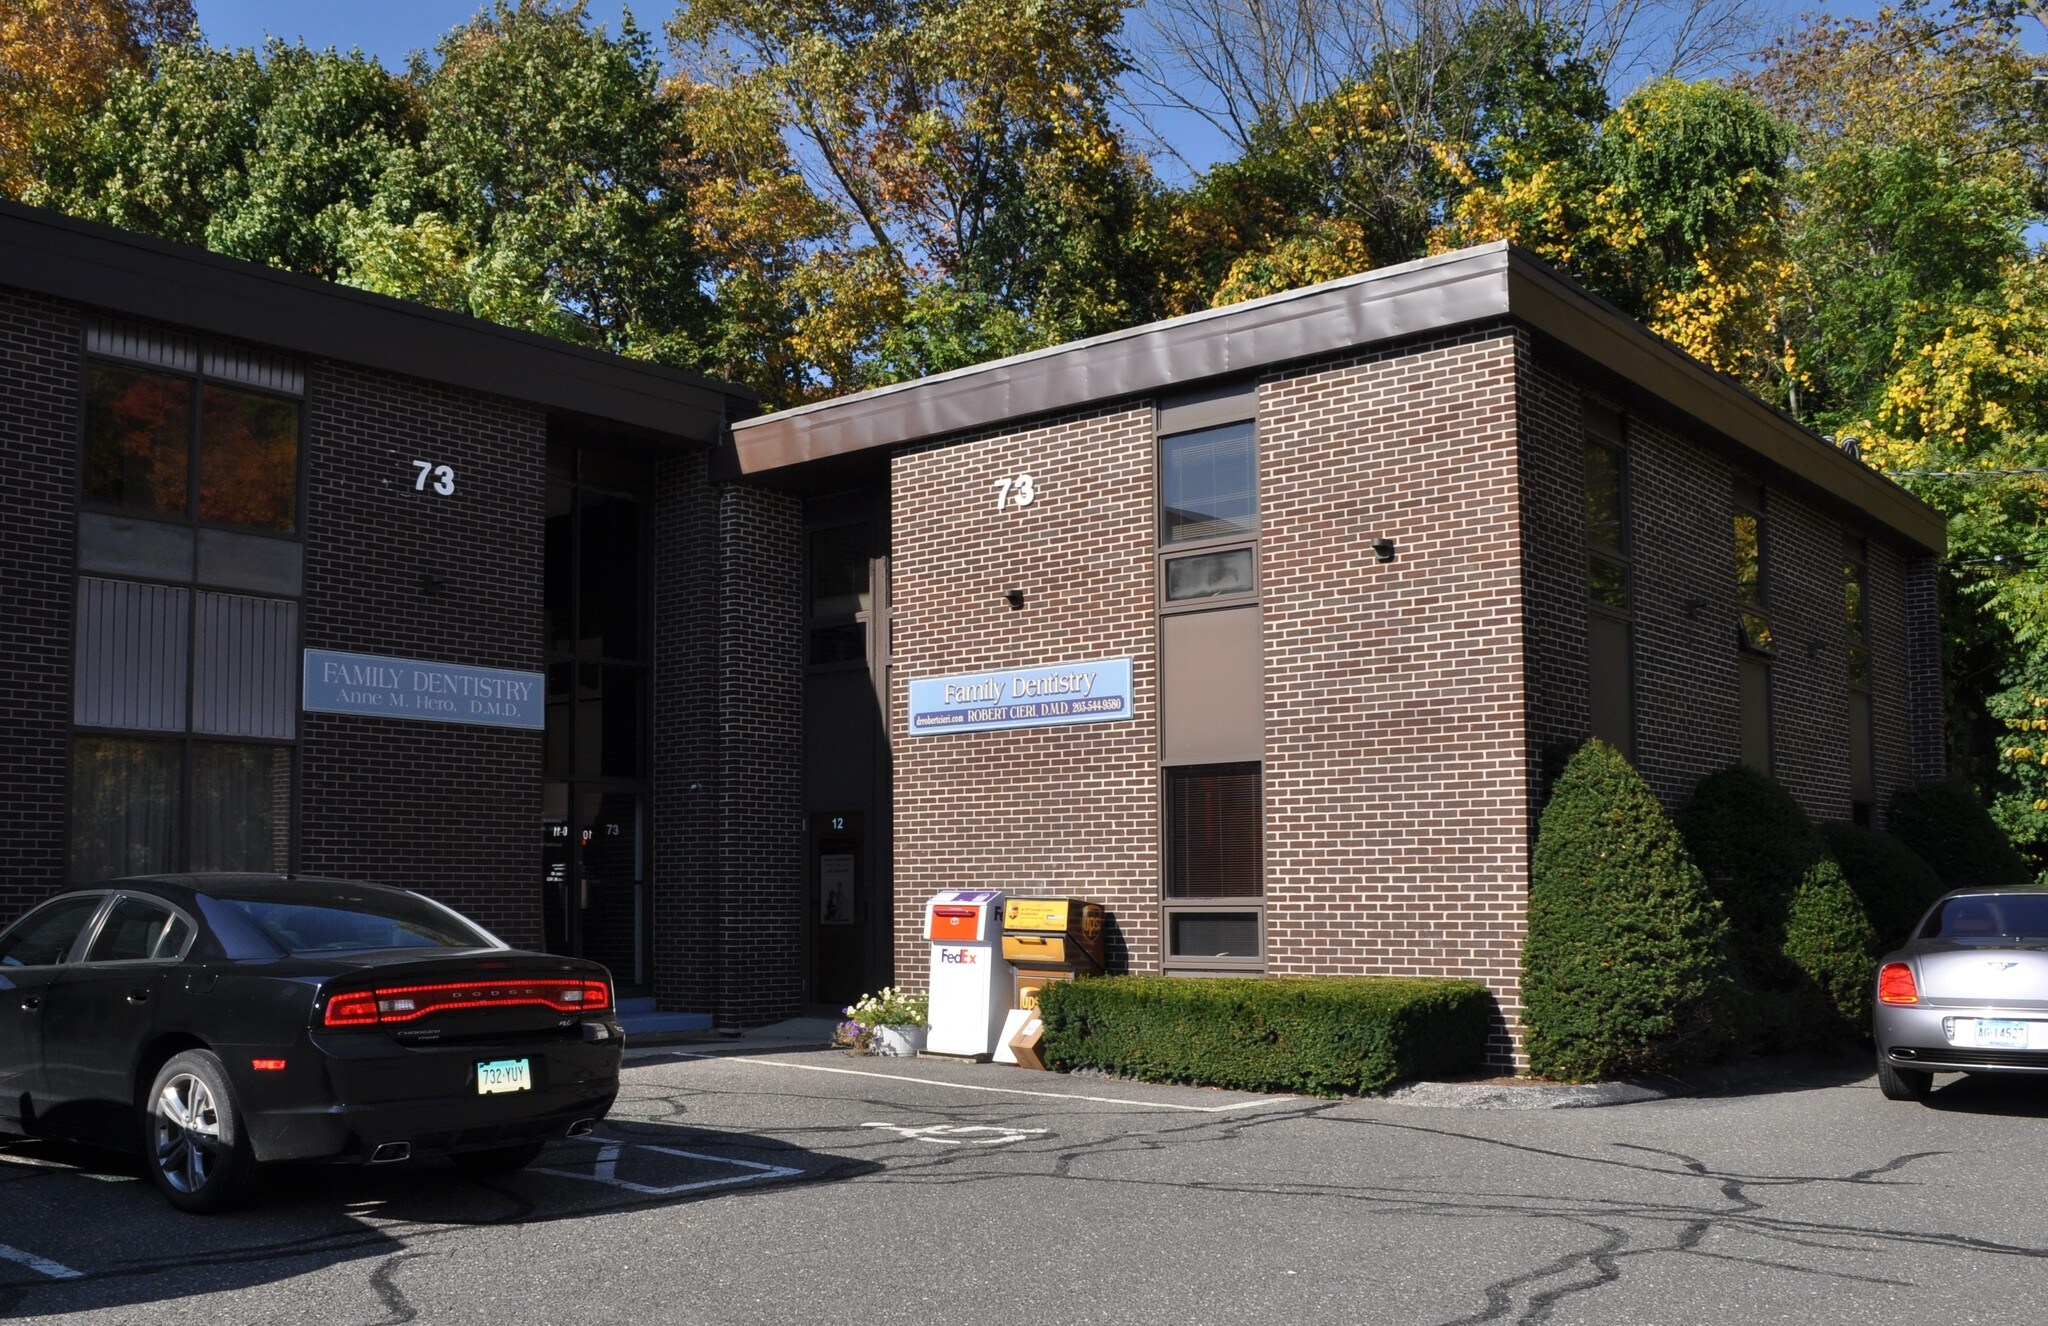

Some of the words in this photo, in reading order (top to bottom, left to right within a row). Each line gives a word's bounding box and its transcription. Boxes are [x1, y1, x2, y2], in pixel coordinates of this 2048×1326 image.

[412, 460, 455, 496] 73
[994, 474, 1035, 510] 73
[323, 662, 404, 689] FAMILY
[413, 671, 533, 701] DENTISTRY
[944, 677, 1005, 705] Family
[1012, 672, 1097, 698] Dentistry
[336, 689, 382, 706] Anne
[389, 692, 409, 707] M.
[470, 700, 521, 717] D.M.D.
[967, 706, 1009, 723] ROBERT
[1072, 698, 1122, 713] 203-544-9580
[606, 824, 619, 835] 73
[832, 817, 843, 829] 12
[1084, 916, 1101, 937] ups
[942, 948, 976, 965] FedEx
[452, 988, 534, 998] DODGE
